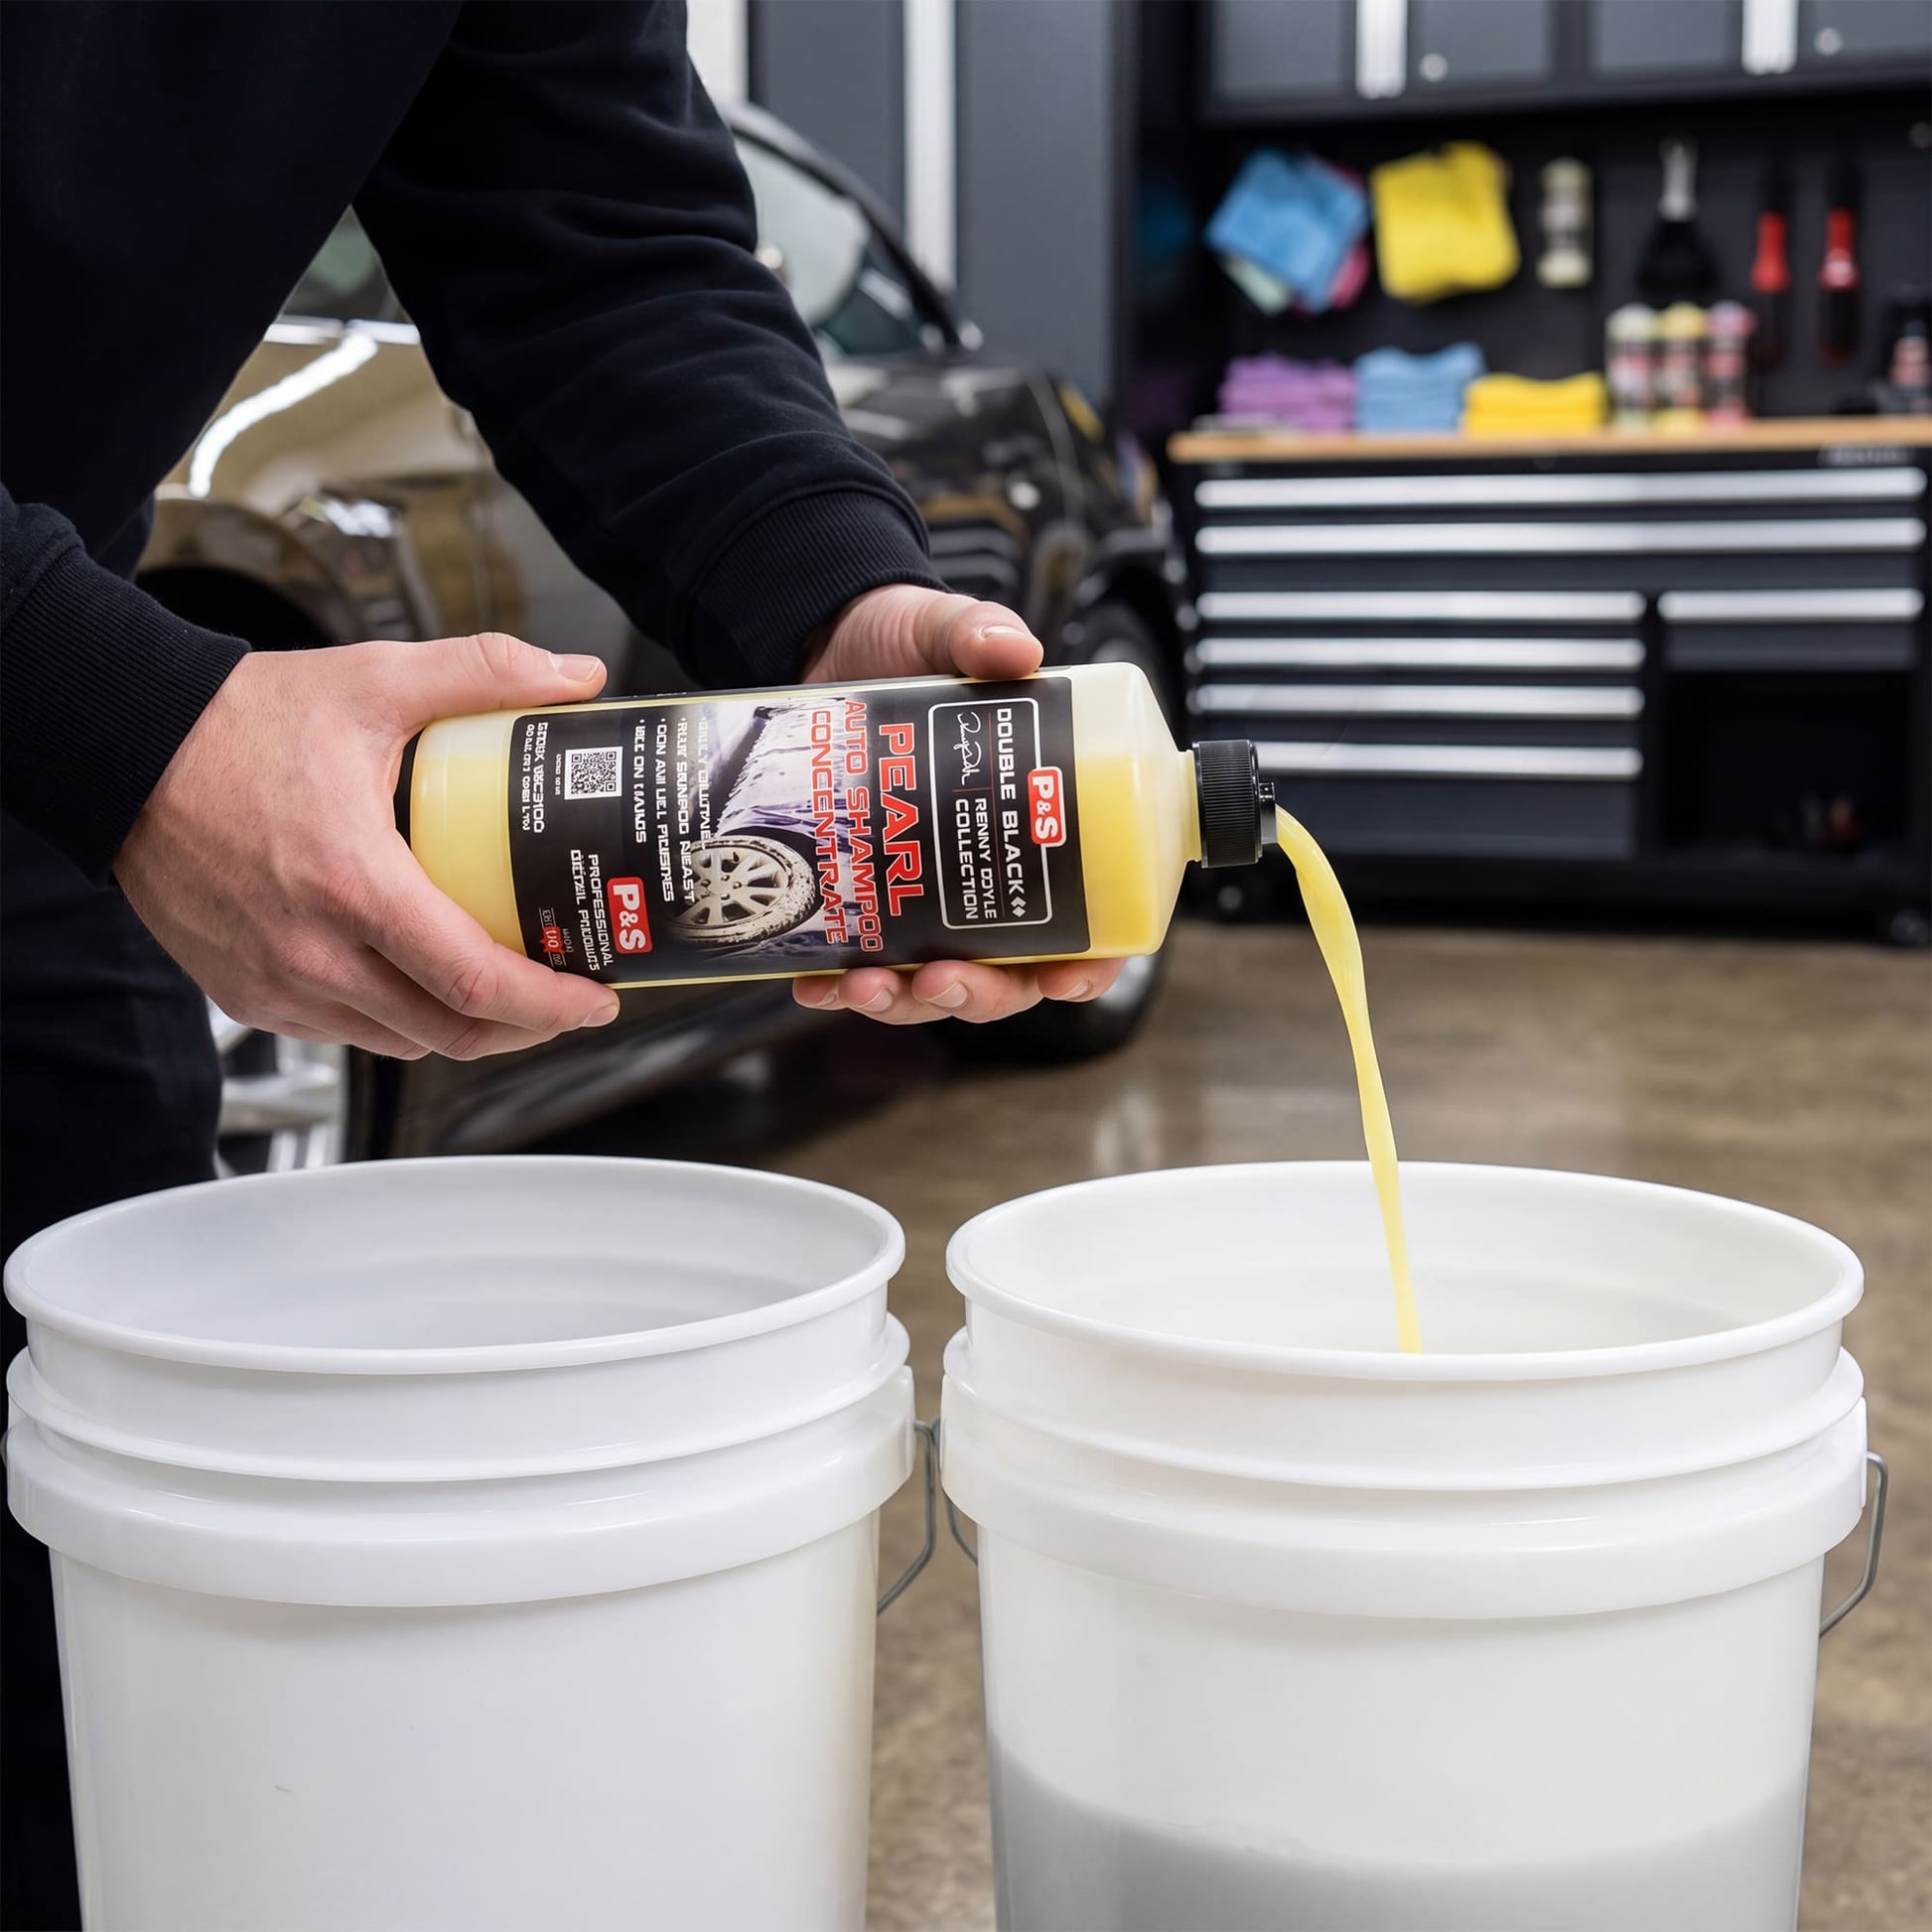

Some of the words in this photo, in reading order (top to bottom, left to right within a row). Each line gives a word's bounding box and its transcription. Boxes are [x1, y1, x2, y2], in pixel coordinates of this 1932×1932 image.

[844, 701, 867, 775] AUTO
[997, 709, 1016, 799] DOUBLE
[810, 710, 848, 945] CONCENTRATE
[879, 723, 924, 915] PEARL
[975, 798, 991, 861] RENNY
[1033, 775, 1057, 839] P&S
[846, 786, 883, 952] SHAMPOO
[955, 798, 978, 919] COLLECTION
[1002, 811, 1025, 895] BLACK
[588, 854, 614, 966] PROFESSIONAL
[613, 885, 645, 950] P&S
